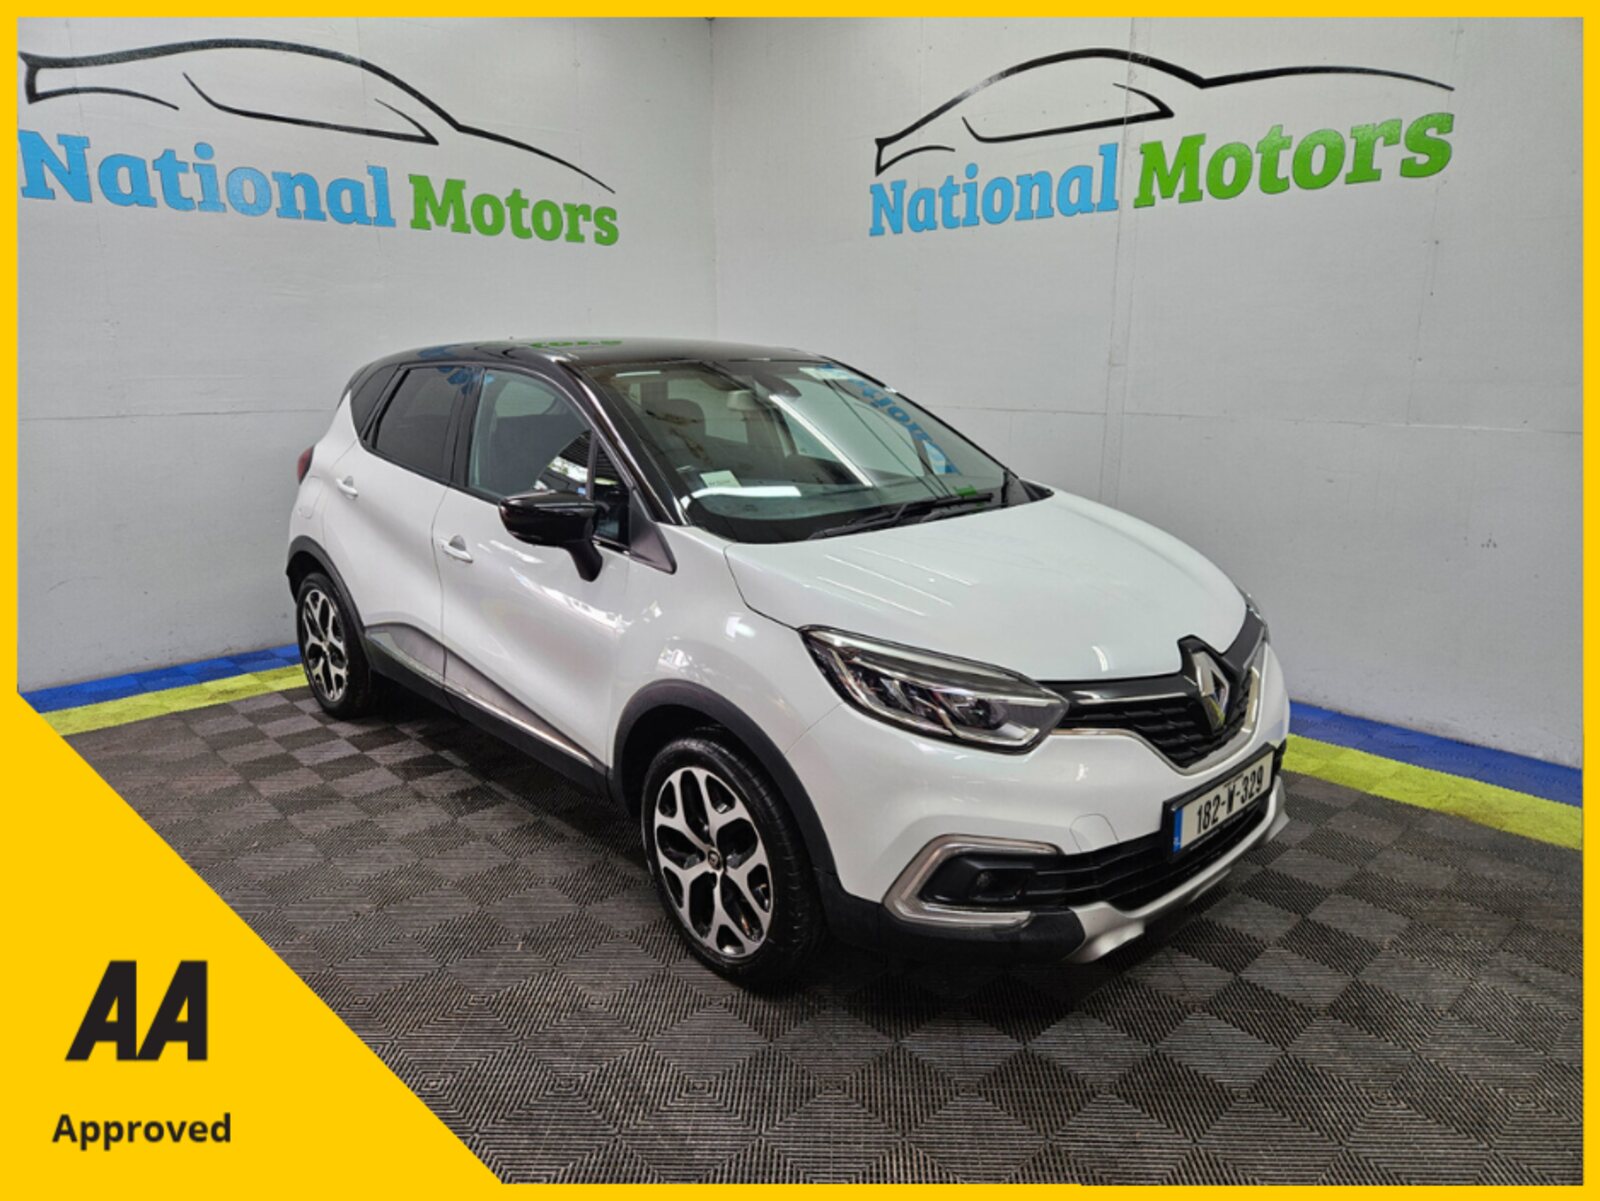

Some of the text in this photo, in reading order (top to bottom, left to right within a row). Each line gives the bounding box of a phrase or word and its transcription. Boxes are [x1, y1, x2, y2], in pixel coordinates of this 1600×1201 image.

[18, 129, 618, 245] National Motors
[869, 113, 1453, 236] National Motors
